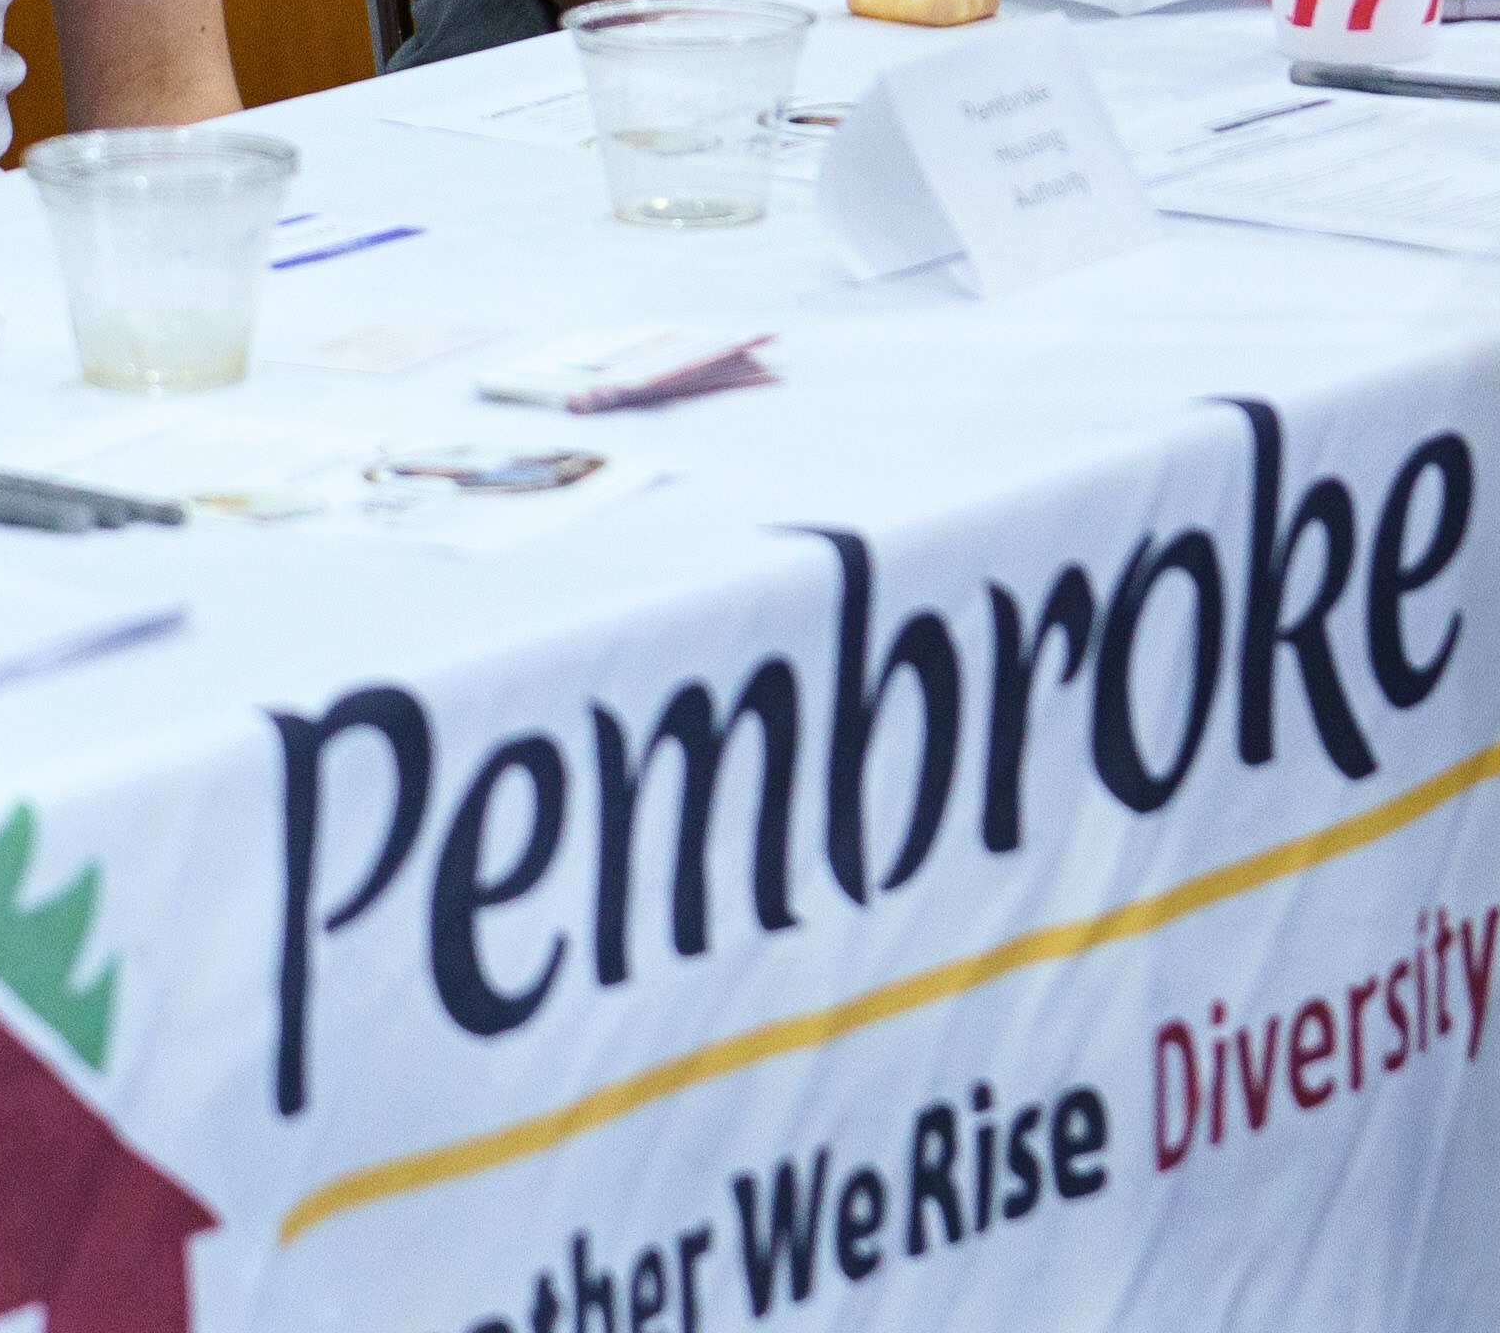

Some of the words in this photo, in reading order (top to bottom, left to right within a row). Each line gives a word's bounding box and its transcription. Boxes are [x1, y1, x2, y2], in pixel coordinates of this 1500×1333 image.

[263, 397, 1476, 1116] Pembroke
[732, 1143, 888, 1318] We
[904, 1080, 1110, 1260] Rise
[1152, 906, 1500, 1174] Diversity
